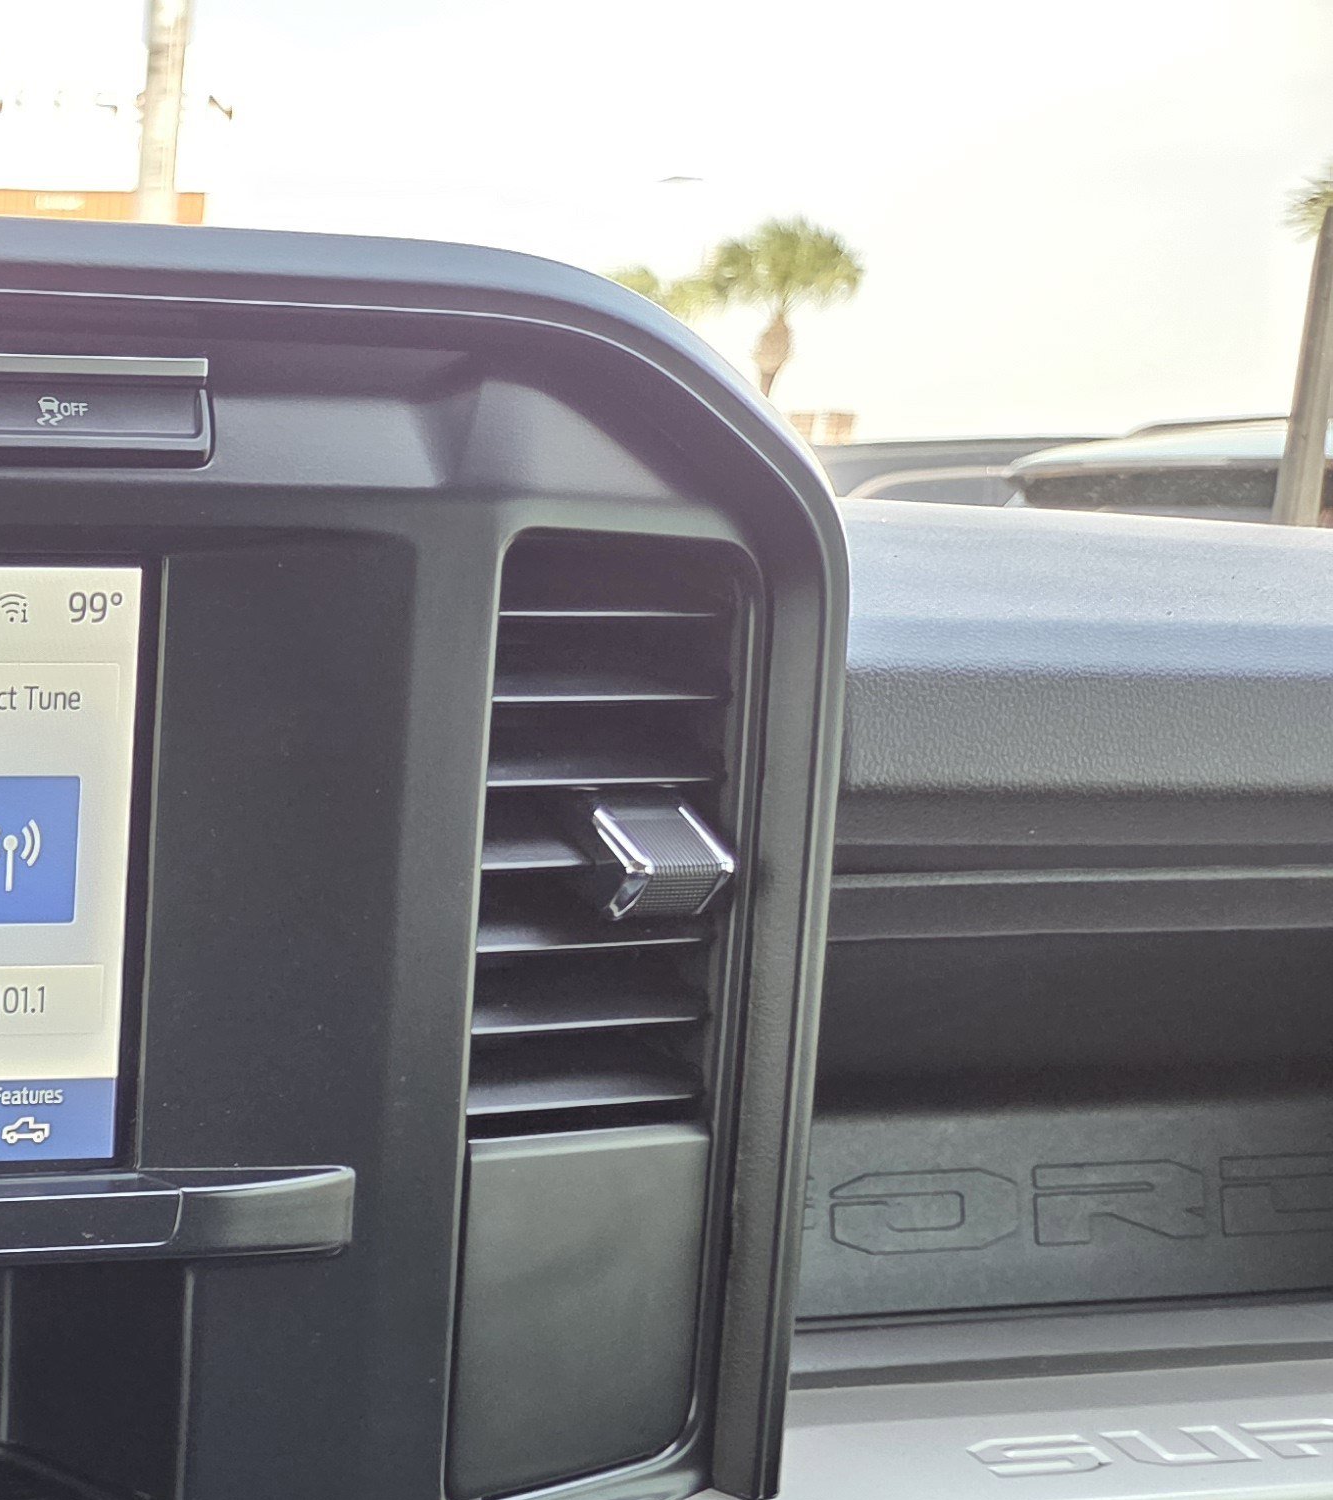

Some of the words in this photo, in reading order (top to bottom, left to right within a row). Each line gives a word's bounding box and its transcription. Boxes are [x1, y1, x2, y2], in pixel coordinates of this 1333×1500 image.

[61, 402, 88, 416] OFF
[68, 591, 123, 624] 99°
[23, 686, 81, 711] Tune
[803, 1153, 1333, 1255] ORD
